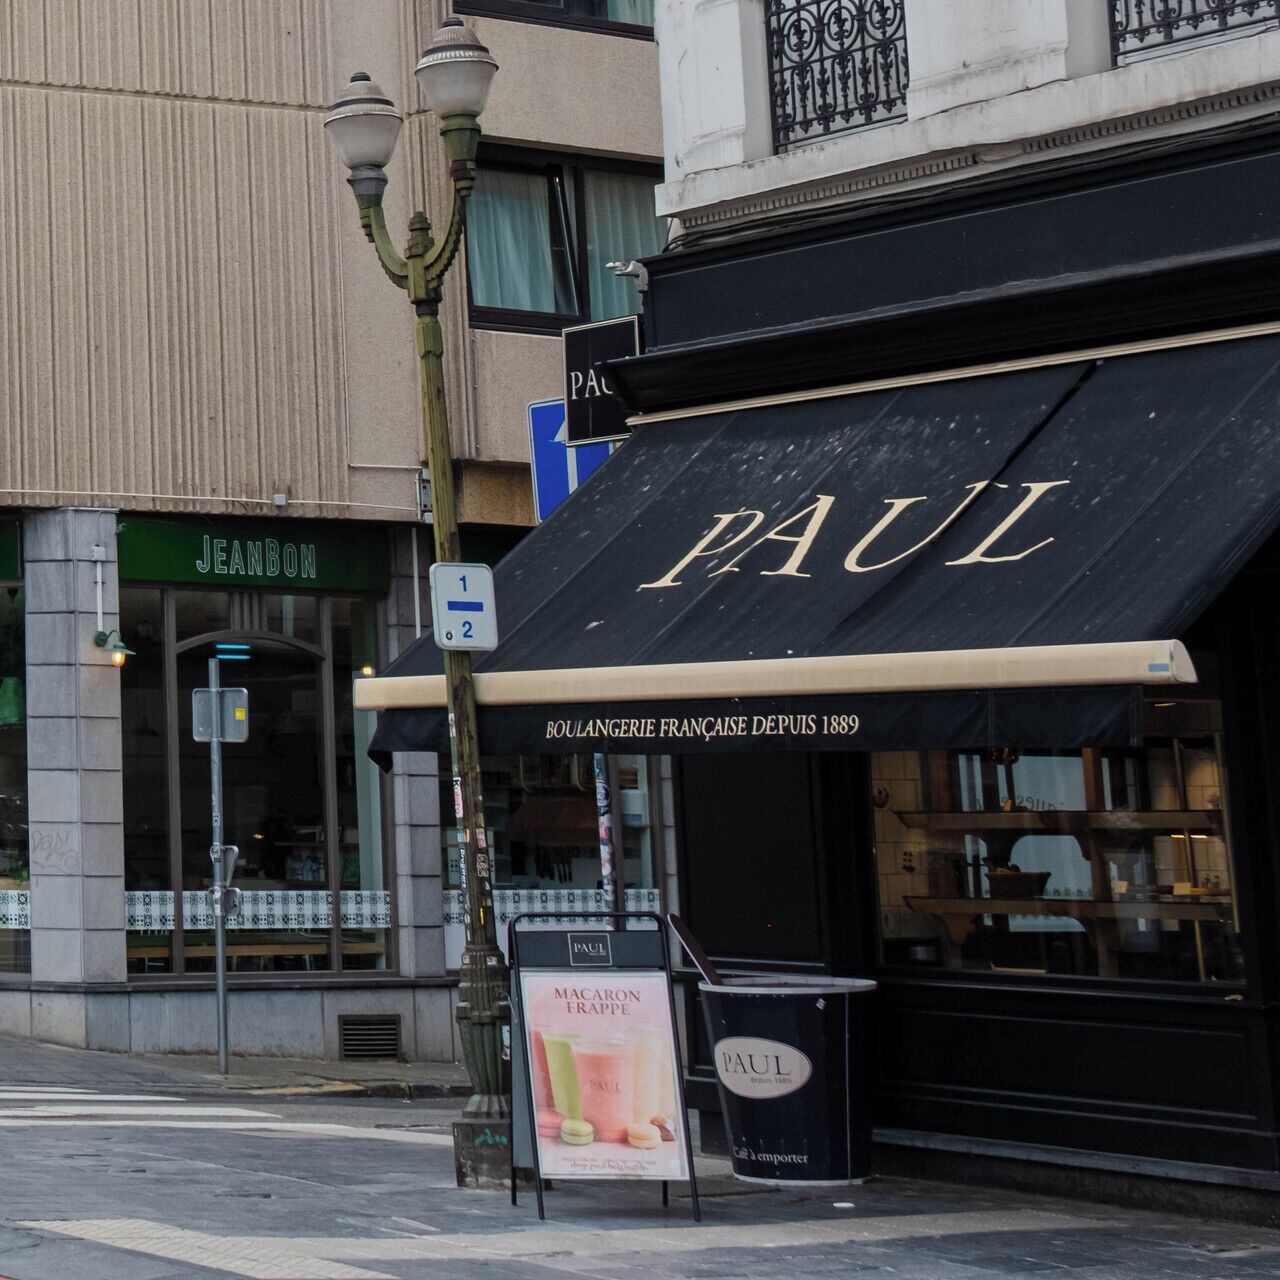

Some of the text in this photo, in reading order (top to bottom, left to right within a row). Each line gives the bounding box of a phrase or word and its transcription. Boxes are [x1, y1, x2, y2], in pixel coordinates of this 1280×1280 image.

[640, 480, 1071, 589] PAUL
[196, 535, 316, 578] JEANBON
[459, 575, 467, 592] 1
[462, 621, 473, 638] 2
[546, 714, 860, 741] BOULANGERIE FRANÇAISE DEPUIS 1889
[574, 942, 606, 953] PAUL
[554, 987, 641, 1002] MACARON
[566, 1001, 631, 1016] FRAPPE
[722, 1052, 792, 1076] PAUL
[758, 1152, 809, 1164] emporter
